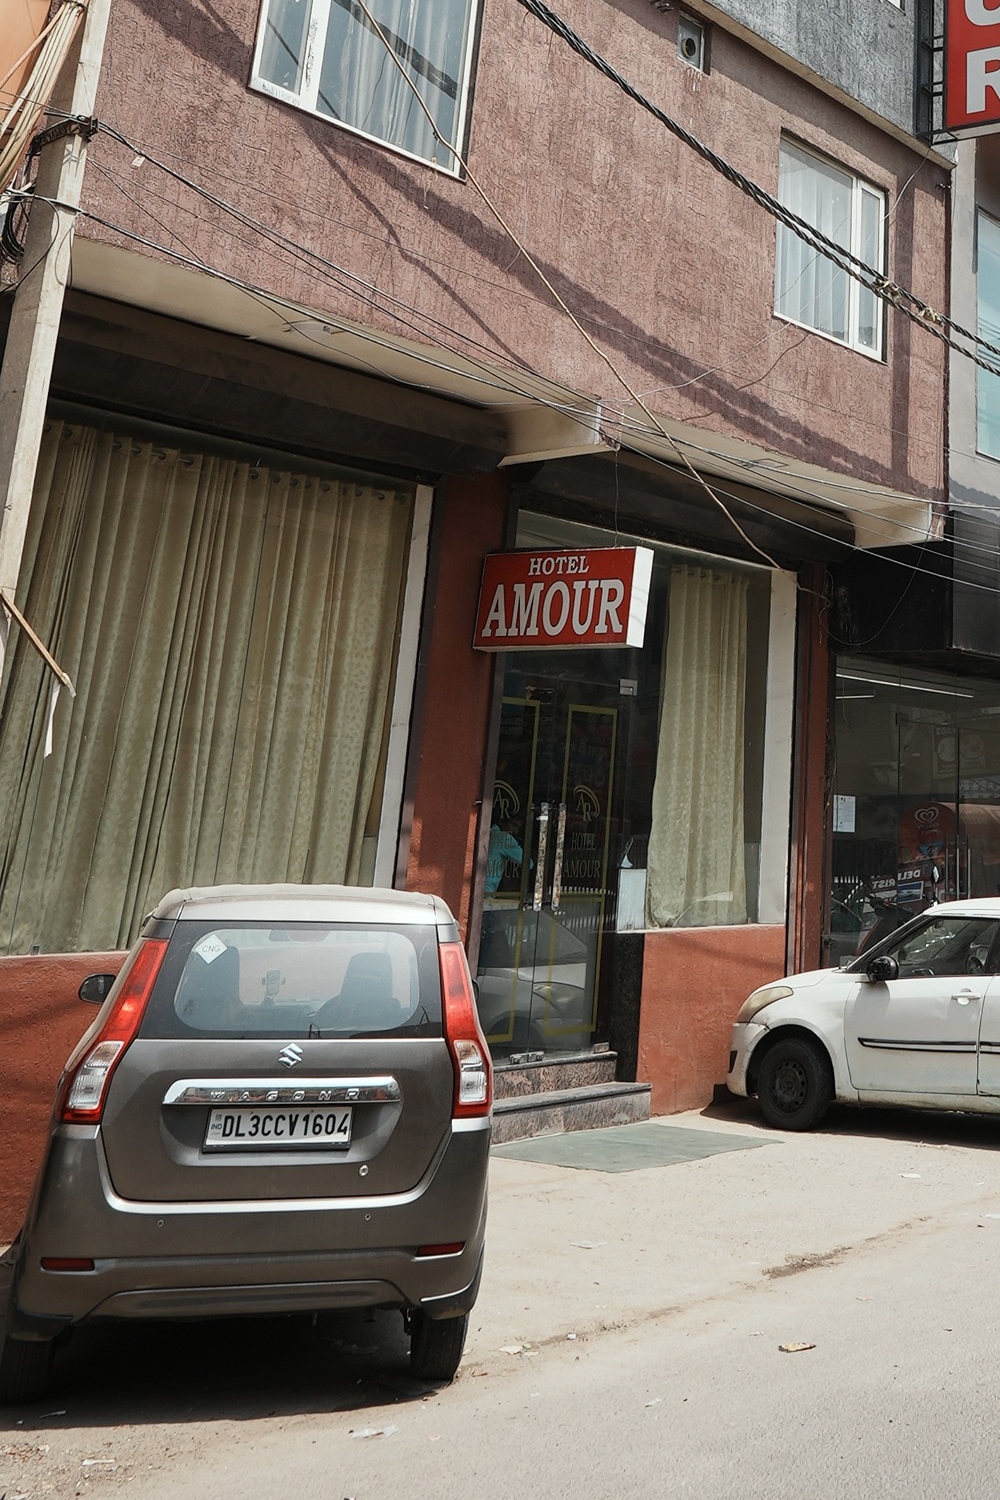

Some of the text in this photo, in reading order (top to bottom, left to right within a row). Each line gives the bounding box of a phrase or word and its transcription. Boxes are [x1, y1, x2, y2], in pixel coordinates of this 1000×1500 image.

[528, 555, 590, 576] HOTEL
[481, 578, 625, 637] AMOUR
[571, 832, 596, 850] HOTEL
[564, 859, 601, 878] AMOUR
[202, 945, 221, 953] CNG
[222, 1113, 350, 1137] DL3CCV1604
